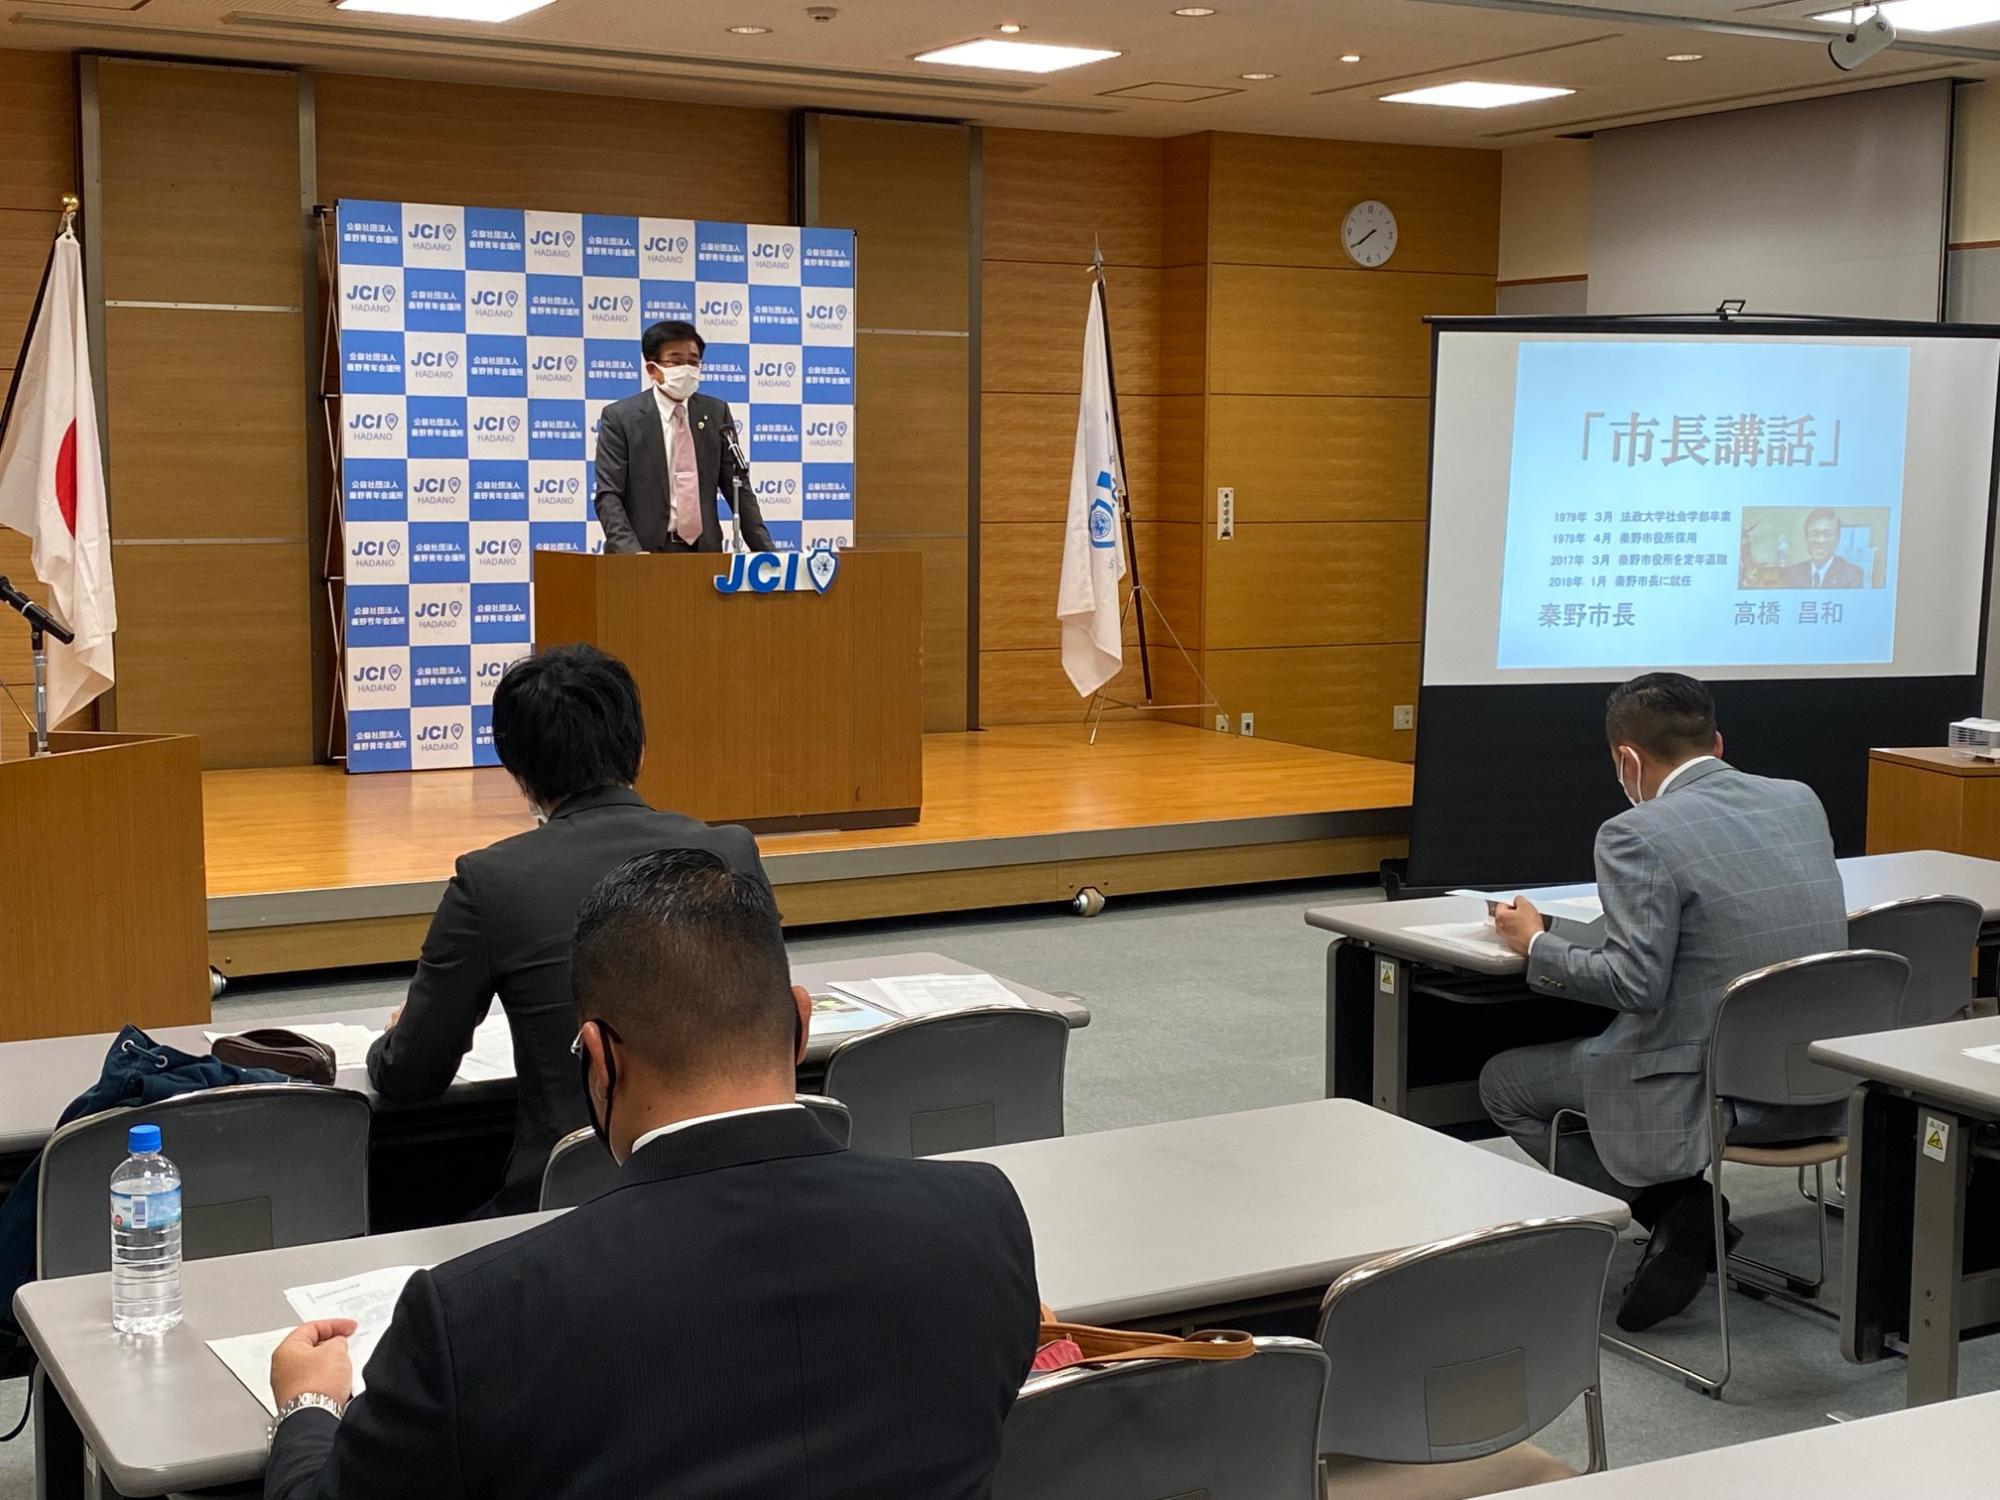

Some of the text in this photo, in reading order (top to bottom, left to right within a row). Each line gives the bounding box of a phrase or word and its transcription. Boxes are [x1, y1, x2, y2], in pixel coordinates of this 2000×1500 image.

[408, 224, 440, 239] JCI
[530, 231, 560, 245] JCI
[413, 242, 450, 251] HADANO
[644, 237, 673, 252] JCI
[752, 244, 780, 258] JCI
[534, 249, 570, 258] HADANO
[648, 255, 683, 263] HADANO
[756, 261, 788, 269] HADANO
[346, 285, 379, 300] JCI
[471, 291, 502, 305] JCI
[351, 304, 390, 312] HADANO
[589, 296, 618, 311] JCI
[700, 301, 728, 315] JCI
[476, 309, 513, 318] HADANO
[592, 314, 628, 322] HADANO
[806, 306, 832, 319] JCI
[810, 322, 842, 330] HADANO
[411, 352, 442, 367] JCI
[532, 356, 562, 371] JCI
[415, 370, 453, 379] HADANO
[754, 363, 782, 377] JCI
[536, 374, 572, 382] HADANO
[758, 380, 791, 388] HADANO
[350, 414, 382, 428] JCI
[474, 417, 504, 431] JCI
[354, 432, 392, 440] HADANO
[806, 423, 833, 436] JCI
[1582, 412, 1840, 468] 「市長講話」
[414, 478, 445, 493] JCI
[534, 479, 565, 494] JCI
[755, 481, 782, 494] JCI
[418, 496, 455, 504] HADANO
[1594, 511, 1613, 522] 3月
[1593, 532, 1611, 543] 4月
[1620, 532, 1697, 544] 秦野市役所採用
[352, 541, 383, 556] JCI
[476, 540, 507, 554] JCI
[480, 558, 516, 566] HADANO
[1551, 554, 1584, 565] 2017年
[1592, 554, 1609, 565] 3月
[715, 553, 799, 593] JCI
[1549, 575, 1692, 587] 2018年 1月 秦野市長に就任
[415, 602, 446, 617] JCI
[1538, 602, 1635, 627] 秦野市長
[1734, 601, 1843, 626] 高橋 昌和
[419, 620, 456, 628] HADANO
[354, 667, 385, 682] JCI
[358, 684, 396, 693] HADANO
[417, 725, 448, 741] JCI
[421, 743, 458, 751] HADANO
